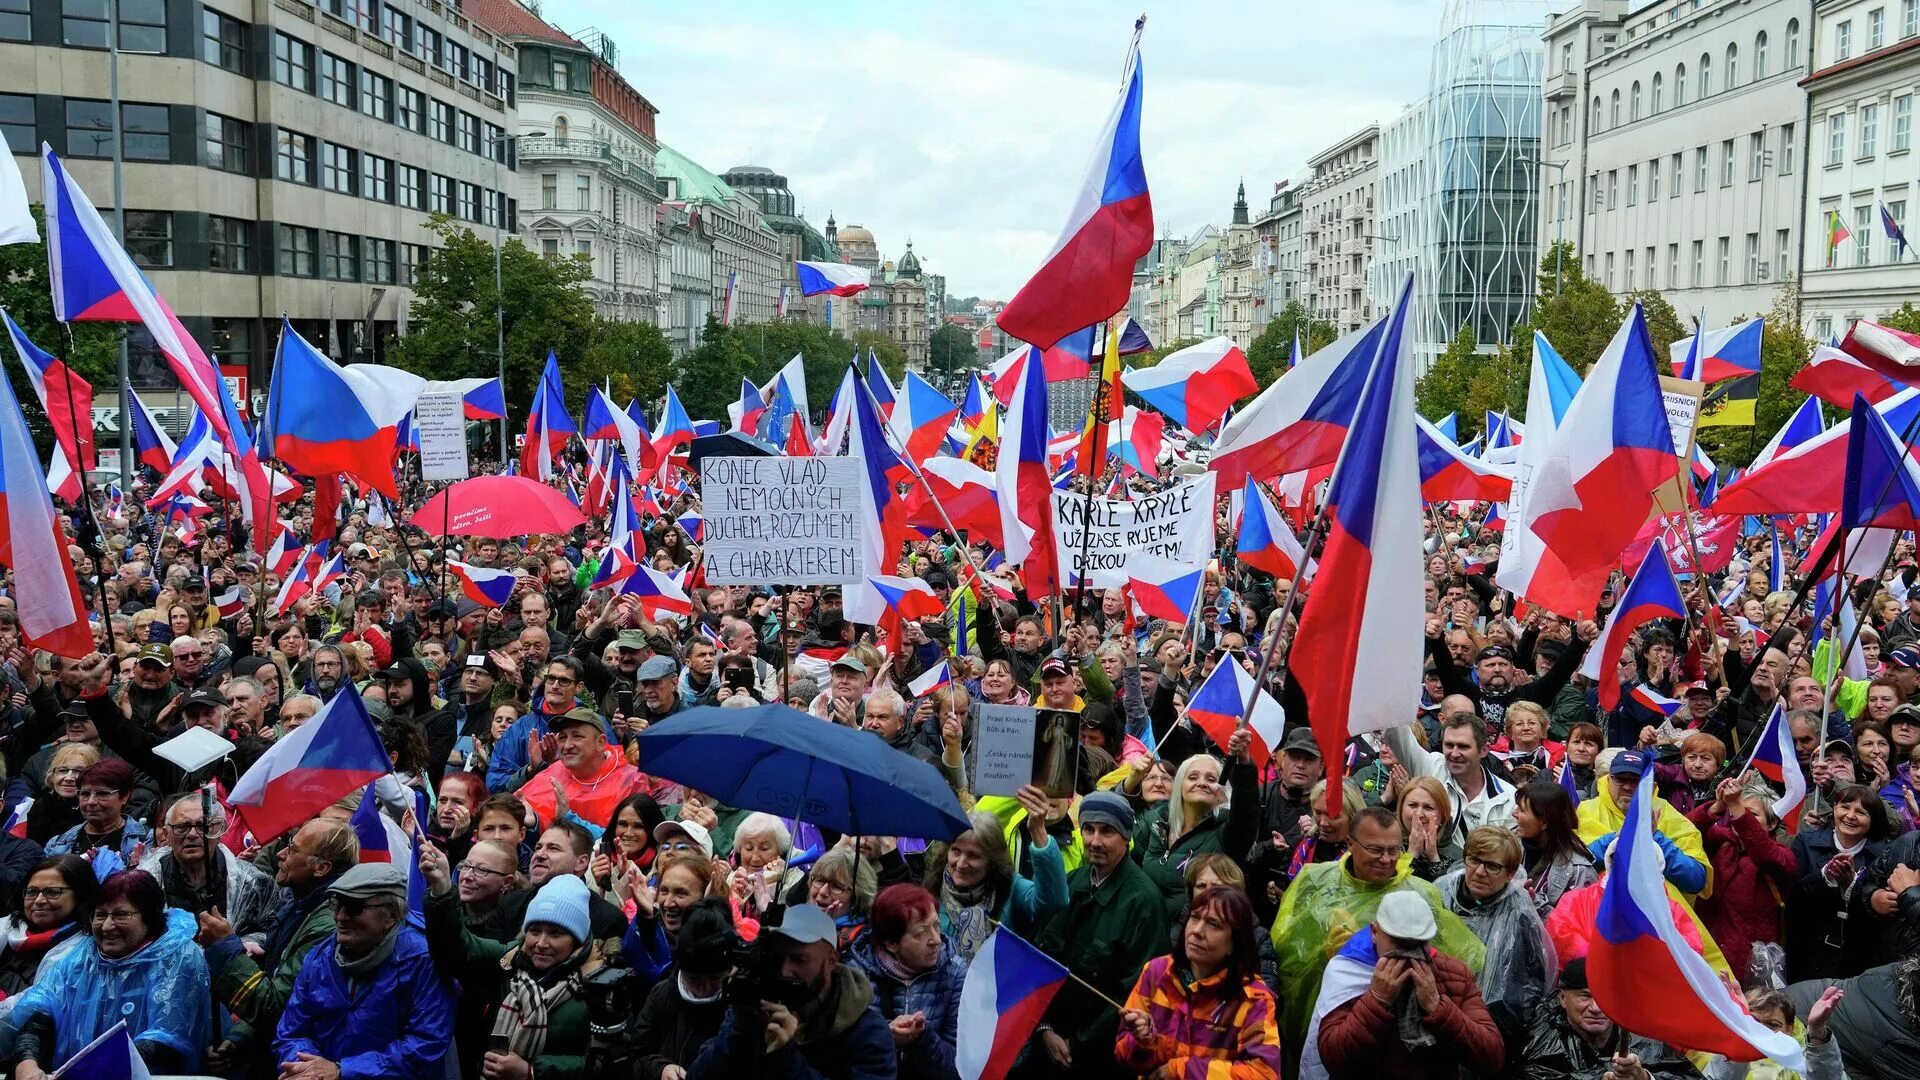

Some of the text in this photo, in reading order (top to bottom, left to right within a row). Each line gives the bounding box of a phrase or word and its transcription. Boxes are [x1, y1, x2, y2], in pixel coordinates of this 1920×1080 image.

[703, 458, 827, 485] KONEC VLÁD
[726, 484, 842, 511] NEMOCNÝCH
[1058, 495, 1121, 527] KARLE
[770, 512, 853, 540] ROZUMEM
[1063, 520, 1178, 548] UŽ ZASE RYJEME
[706, 546, 855, 579] A CHARAKTEREM
[1073, 551, 1126, 570] DRŽKOU
[1005, 716, 1028, 724] Kristus
